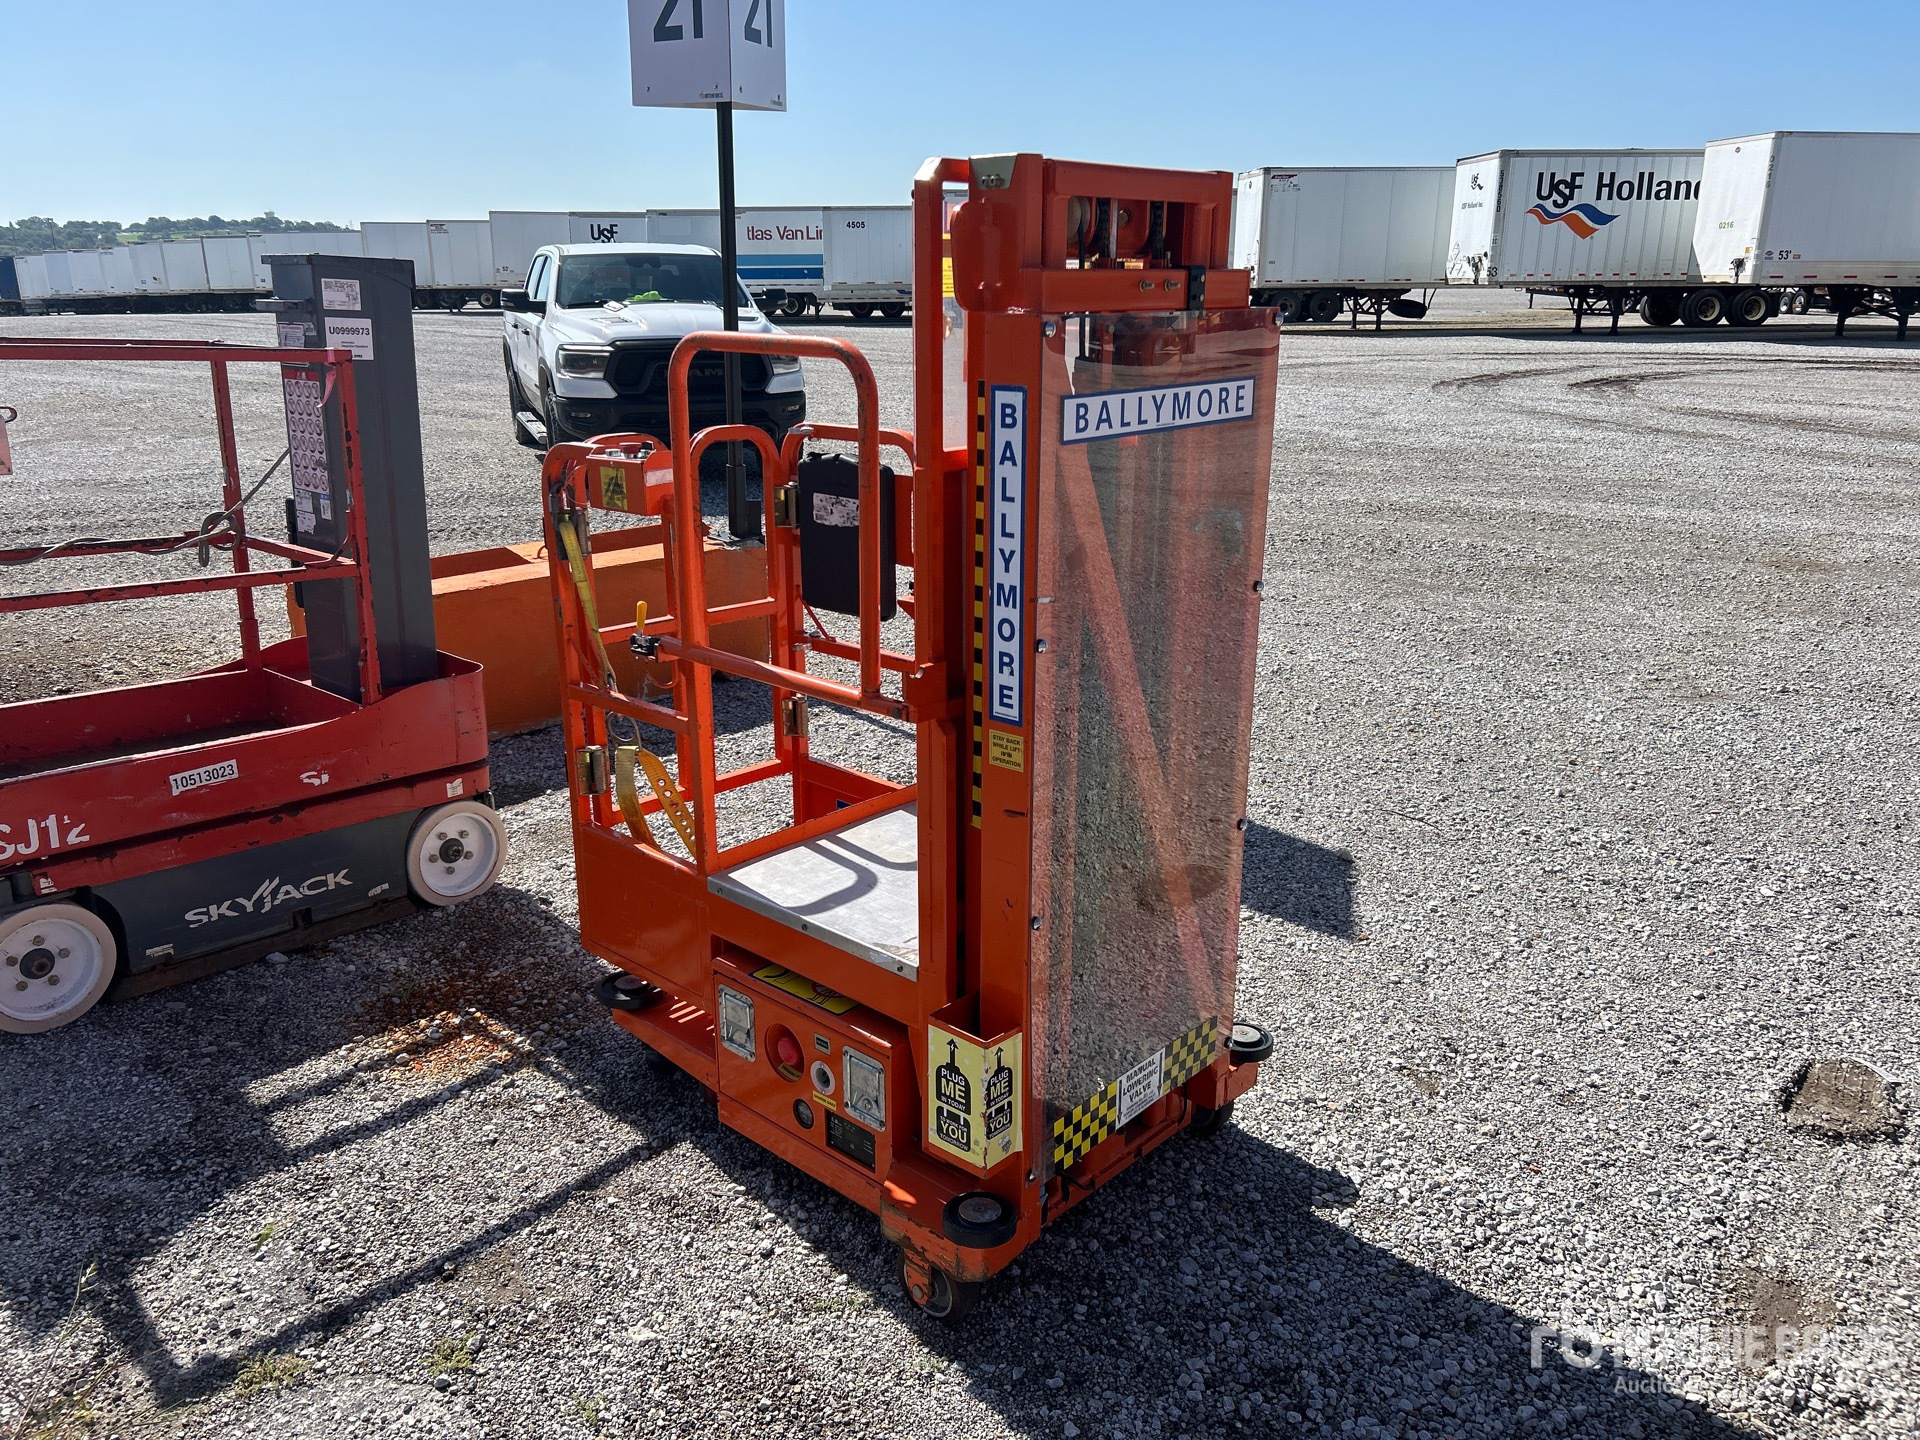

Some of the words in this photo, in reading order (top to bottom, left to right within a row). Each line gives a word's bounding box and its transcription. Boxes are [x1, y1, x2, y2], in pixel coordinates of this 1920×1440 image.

[1536, 171, 1585, 209] USF
[590, 223, 619, 243] USF
[775, 225, 804, 241] Van
[846, 221, 866, 229] 4505
[1718, 221, 1734, 229] 0216
[1778, 249, 1792, 260] 53'
[328, 326, 371, 336] U0999973
[1074, 384, 1247, 435] BALLYMORE
[996, 402, 1019, 710] BALLYMORE
[991, 755, 1022, 768] OPERATION
[172, 764, 235, 790] 10513023
[184, 868, 354, 928] SKYJACK
[941, 1067, 965, 1086] PLUG
[990, 1069, 1009, 1086] PLUG
[1126, 1057, 1156, 1084] MANUAL
[941, 1077, 966, 1104] ME
[990, 1077, 1009, 1100] ME
[1122, 1065, 1159, 1097] LOWERING
[1129, 1080, 1152, 1103] VALVE
[948, 1098, 966, 1112] TODAY
[940, 1120, 967, 1144] YOU
[989, 1112, 1010, 1132] YOU
[939, 1132, 968, 1151] TOMORROW
